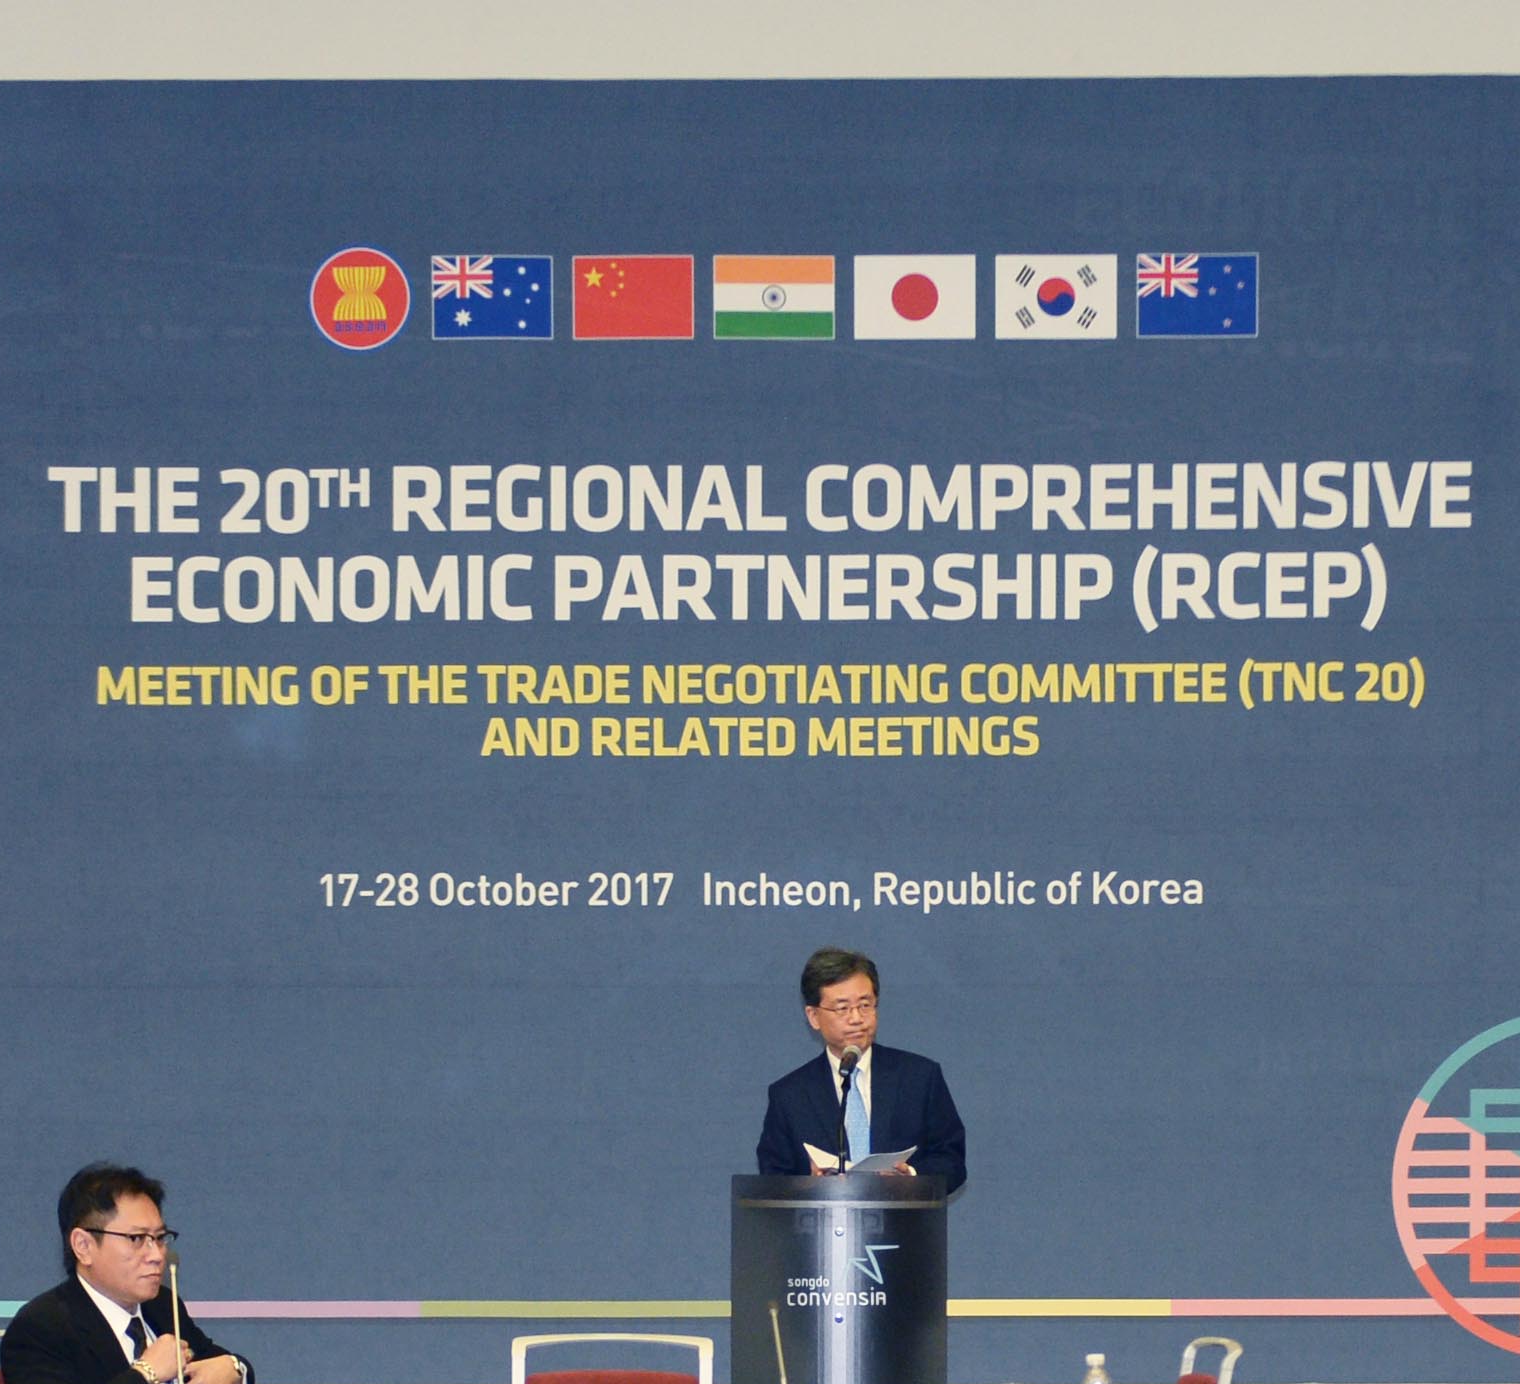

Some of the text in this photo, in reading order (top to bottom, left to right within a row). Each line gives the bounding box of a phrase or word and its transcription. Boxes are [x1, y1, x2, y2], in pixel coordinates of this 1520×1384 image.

[47, 460, 1473, 535] THE 20TH REGIONAL COMPREHENSIVE
[131, 544, 1388, 633] ECONOMIC PARTNERSHIP (RCEP)
[96, 656, 1425, 710] MEETING OF THE TRADE NEGOTIATING COMMITTEE (TNC 20)
[480, 715, 1040, 757] AND RELATED MEETINGS
[319, 870, 1204, 914] 17-28 October 2017 Incheon, Republic of Korea
[787, 1275, 830, 1290] songdo
